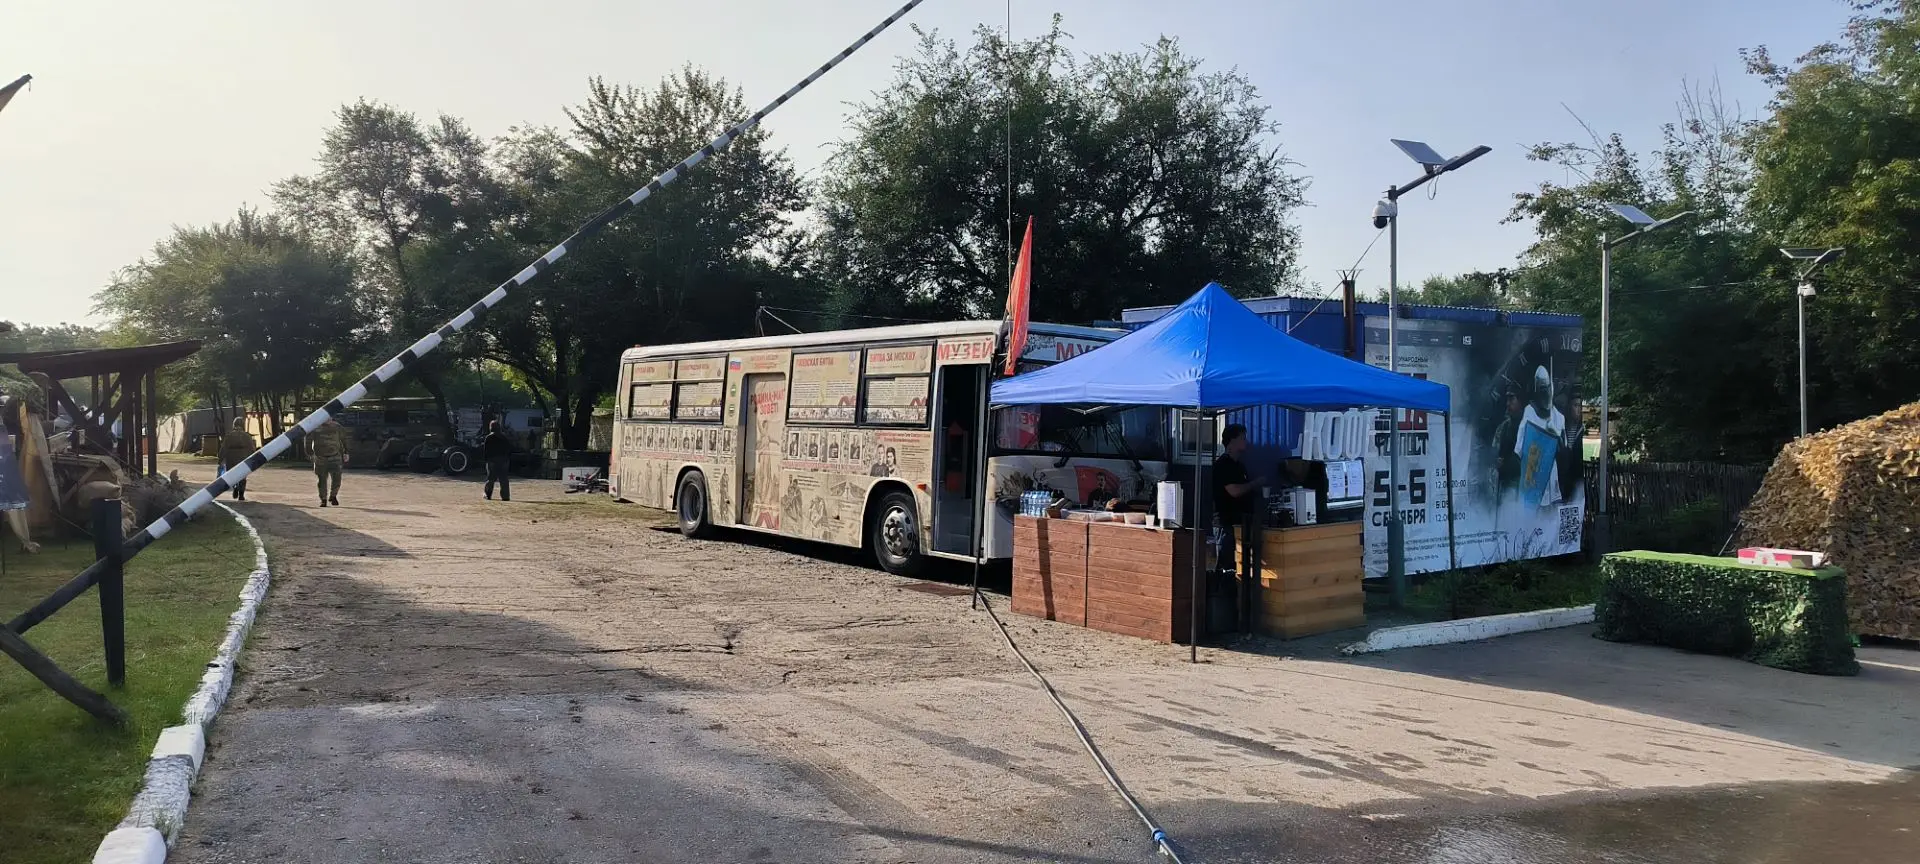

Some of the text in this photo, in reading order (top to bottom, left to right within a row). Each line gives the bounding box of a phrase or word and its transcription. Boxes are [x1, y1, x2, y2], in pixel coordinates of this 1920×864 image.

[937, 337, 993, 360] МУЗЕЙ
[1056, 342, 1101, 361] МУ
[1302, 408, 1380, 460] КОФЕ
[1375, 432, 1429, 456] ФОПОСТ
[1435, 468, 1447, 476] 5.0
[1373, 469, 1426, 506] 5-6
[1372, 509, 1426, 527] СЕЯБРЯ
